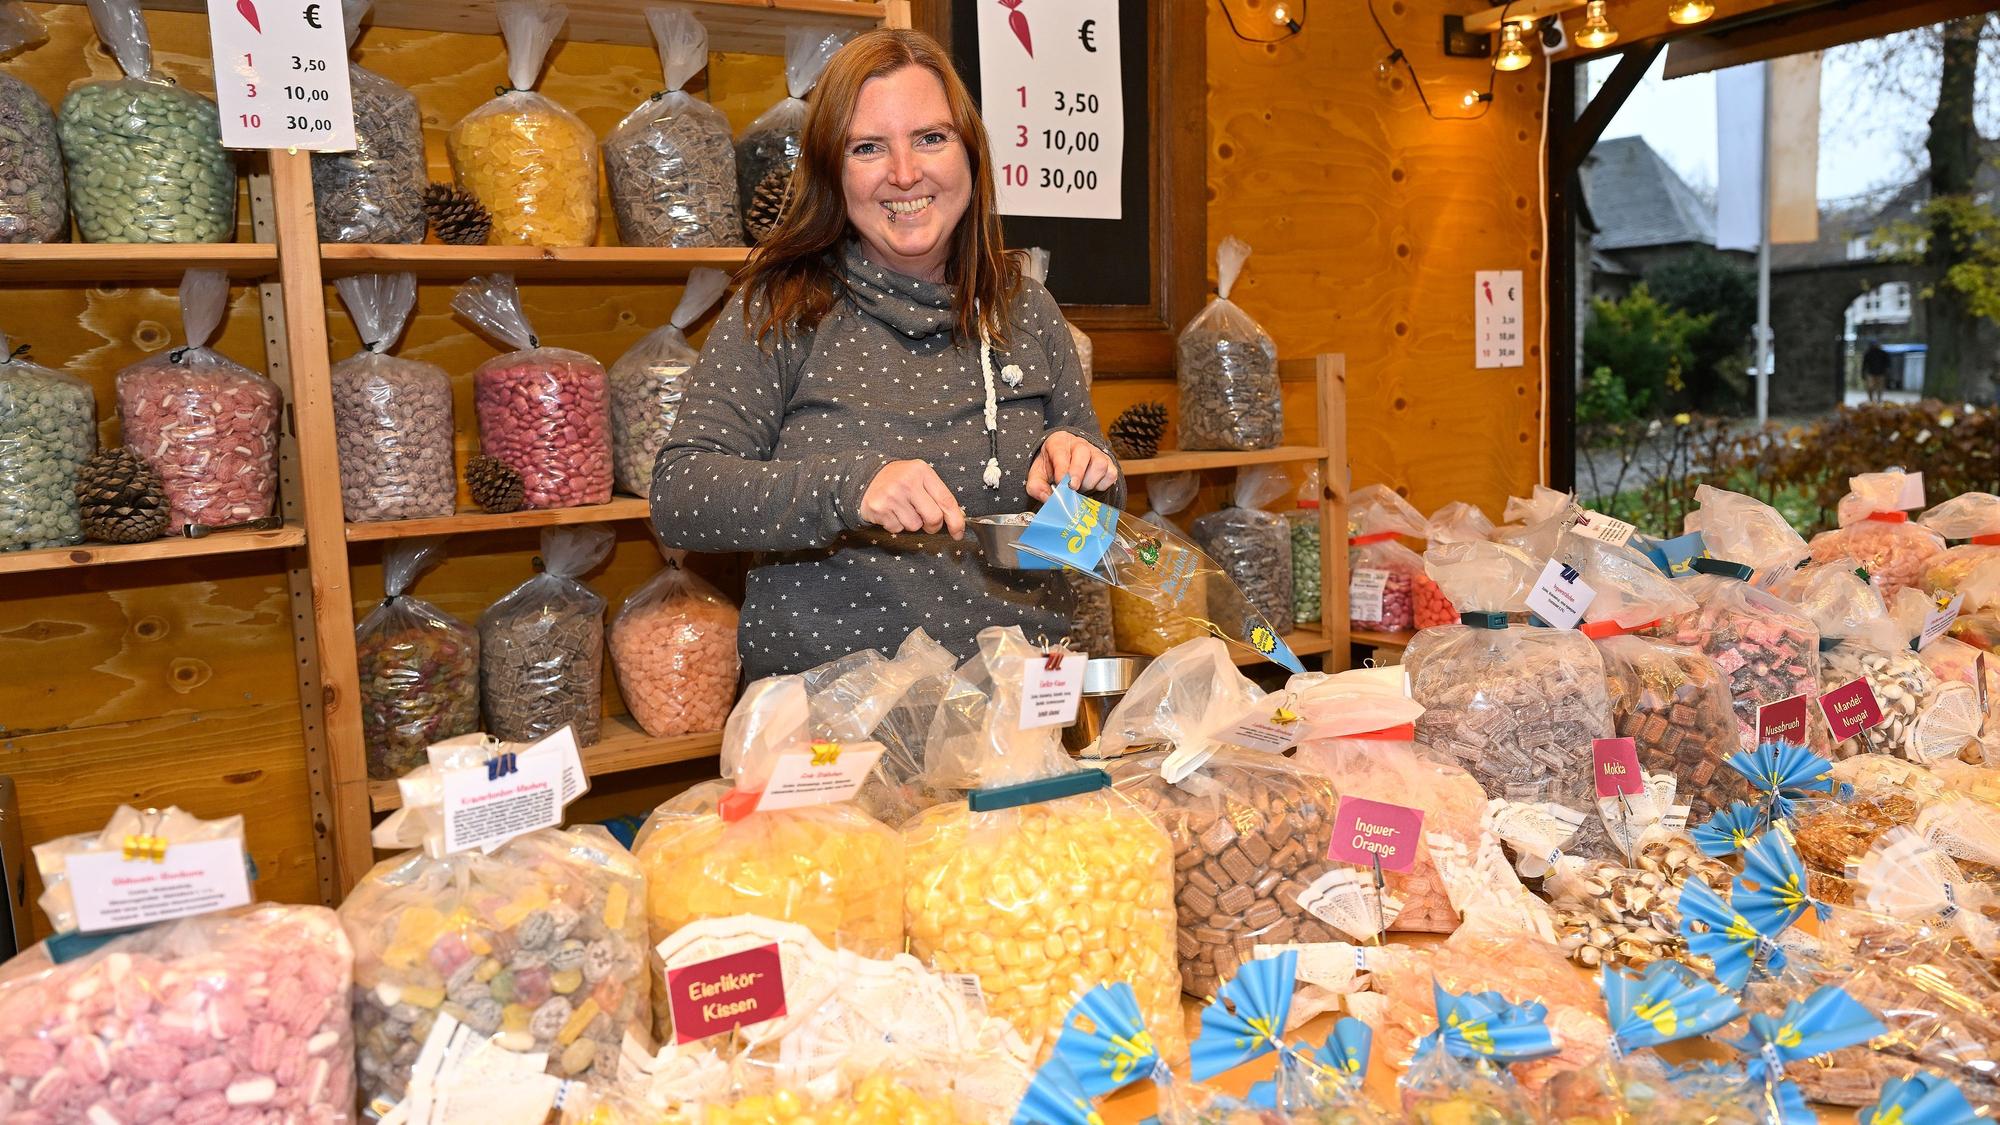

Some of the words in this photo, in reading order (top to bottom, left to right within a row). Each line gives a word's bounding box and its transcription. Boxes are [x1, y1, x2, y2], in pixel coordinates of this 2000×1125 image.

[303, 4, 322, 29] €
[1078, 19, 1097, 52] €
[244, 53, 252, 67] 1
[291, 56, 326, 73] 3,50
[246, 84, 257, 98] 3
[284, 86, 329, 102] 10,00
[1017, 86, 1027, 108] 1
[1054, 91, 1099, 116] 3,50
[240, 114, 261, 128] 10
[286, 116, 332, 132] 30,00
[1016, 125, 1028, 147] 3
[1042, 129, 1099, 155] 10,00
[1002, 164, 1028, 187] 10
[1040, 168, 1097, 193] 30,00
[1833, 693, 1862, 714] Mandel-
[1765, 717, 1800, 736] Nussbruch
[1842, 709, 1869, 728] Nougat
[1604, 761, 1626, 775] Mokka
[1355, 817, 1401, 837] Ingwer-
[1352, 835, 1396, 858] Orange
[688, 973, 764, 1001] Eierlikör-
[702, 998, 758, 1023] Kissen
